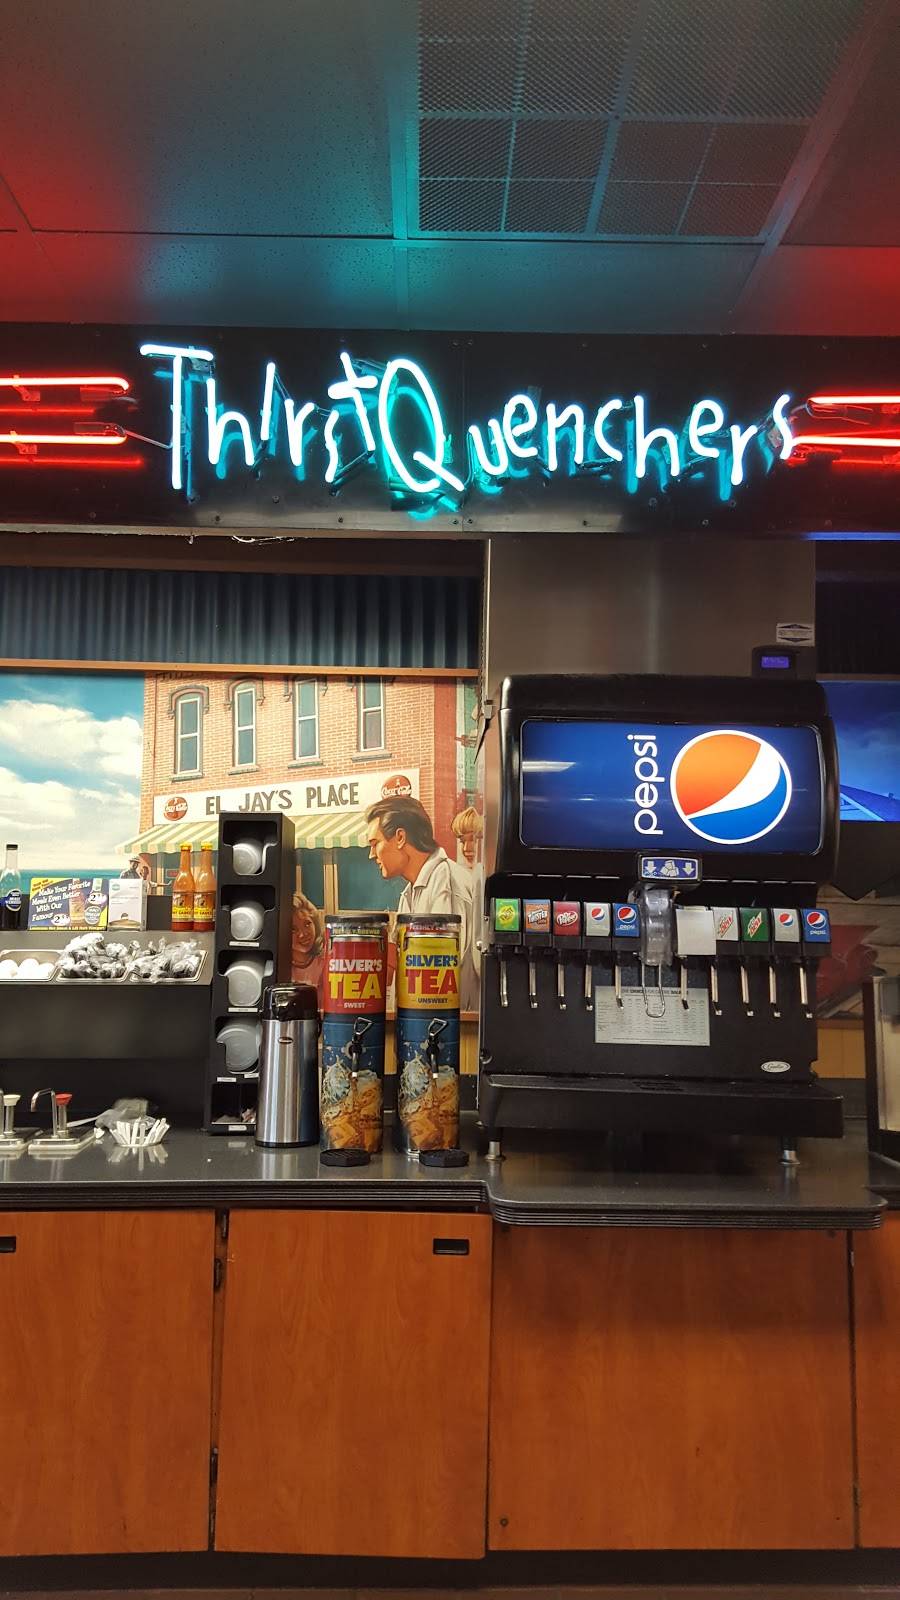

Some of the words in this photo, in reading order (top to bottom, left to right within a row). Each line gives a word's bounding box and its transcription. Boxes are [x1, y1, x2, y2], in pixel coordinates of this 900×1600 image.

[627, 734, 666, 835] pepsi
[205, 795, 226, 815] EL
[238, 789, 293, 813] JAY'S
[306, 782, 359, 808] PLACE
[38, 888, 55, 897] Make
[54, 885, 68, 894] Your
[68, 880, 91, 890] Favorite
[48, 894, 62, 903] Even
[62, 891, 80, 900] Better
[36, 903, 51, 913] With
[51, 902, 62, 910] Our
[328, 958, 383, 973] SILVER'S
[405, 954, 458, 968] SILVER'S
[328, 973, 383, 1000] TEA
[405, 969, 459, 995] TEA
